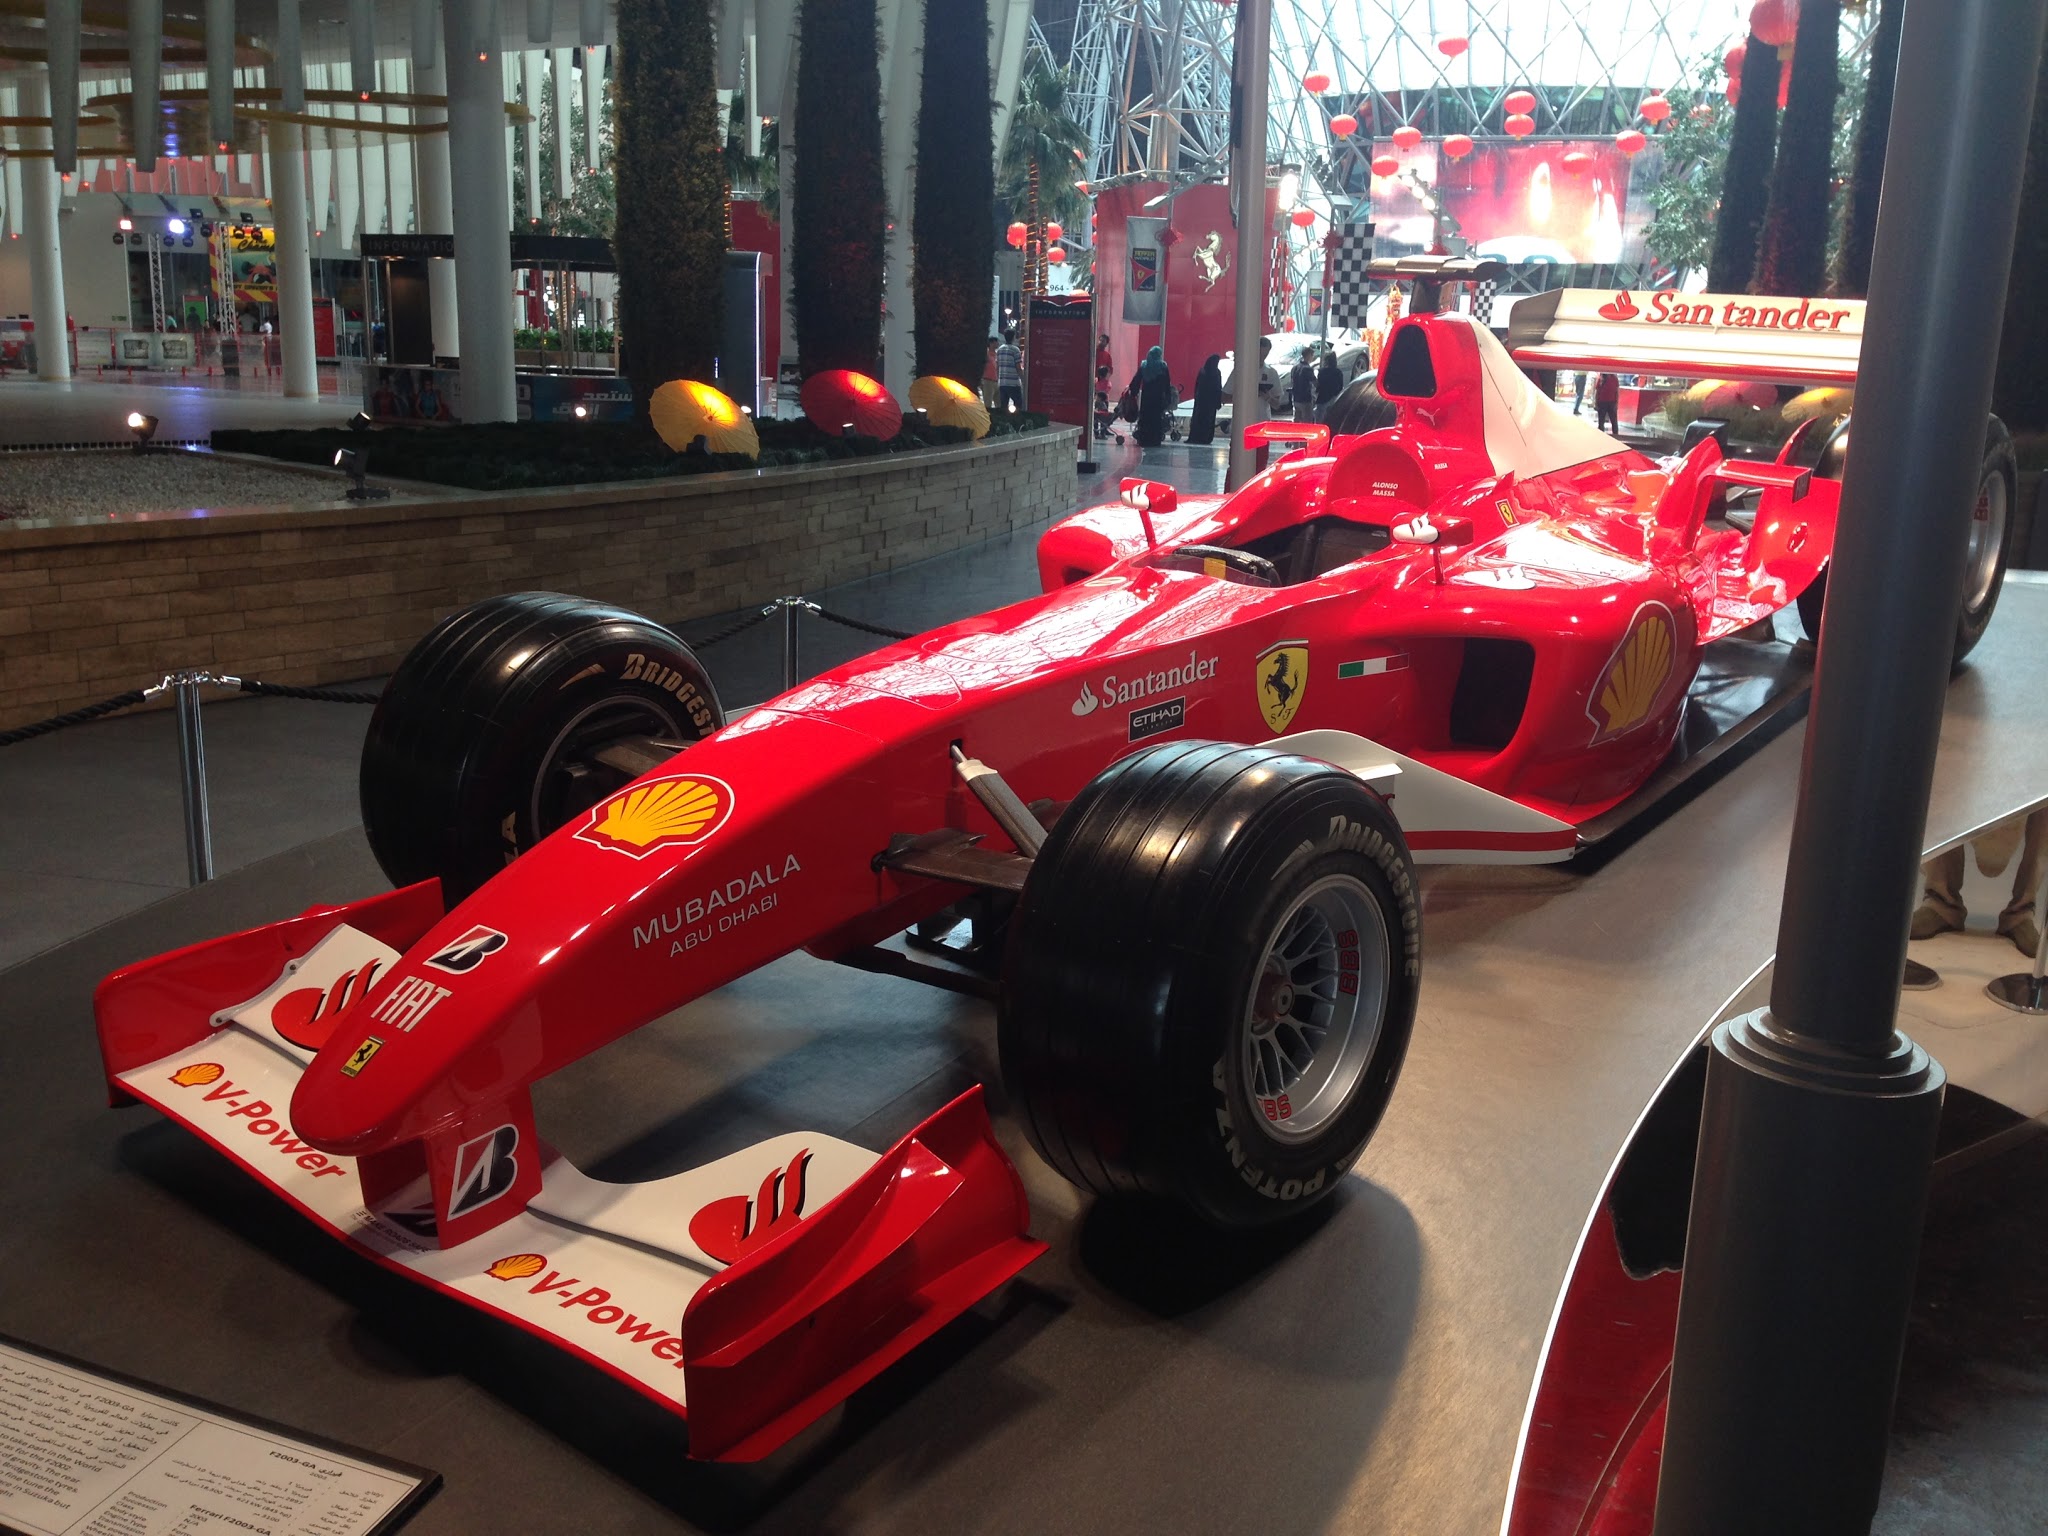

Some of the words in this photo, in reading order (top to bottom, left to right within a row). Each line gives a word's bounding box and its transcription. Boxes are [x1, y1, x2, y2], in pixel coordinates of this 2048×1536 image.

[368, 240, 454, 251] INFORMATIO
[1372, 489, 1395, 497] MASSA
[1102, 650, 1219, 709] Santander
[620, 653, 716, 736] BRIDGEST
[1133, 704, 1182, 728] ETIHAD
[631, 853, 802, 950] MUBADALA
[1329, 814, 1420, 977] BRIDGESTONE
[669, 928, 713, 957] ABU
[719, 893, 779, 935] DHABI
[1337, 929, 1360, 996] BBS
[371, 975, 453, 1033] FIAT
[1257, 1093, 1292, 1121] BS
[204, 1081, 348, 1179] V-Power
[10, 1436, 28, 1447] take
[28, 1444, 47, 1454] part
[57, 1453, 72, 1462] the
[74, 1459, 102, 1473] World
[15, 1447, 30, 1456] for
[29, 1452, 44, 1461] the
[269, 1451, 316, 1470] F2003-GA
[2, 1461, 55, 1484] Bridgestone
[5, 1471, 23, 1481] fine
[23, 1479, 44, 1490] tune
[44, 1486, 60, 1496] the
[45, 1467, 61, 1477] The
[61, 1474, 81, 1484] rear
[22, 1487, 54, 1504] Suzuka
[54, 1500, 71, 1510] but
[115, 1501, 134, 1510] Class
[128, 1491, 168, 1509] Production
[103, 1510, 128, 1522] Engine
[189, 1504, 224, 1520] Ferrari
[223, 1516, 272, 1536] F2003-GA
